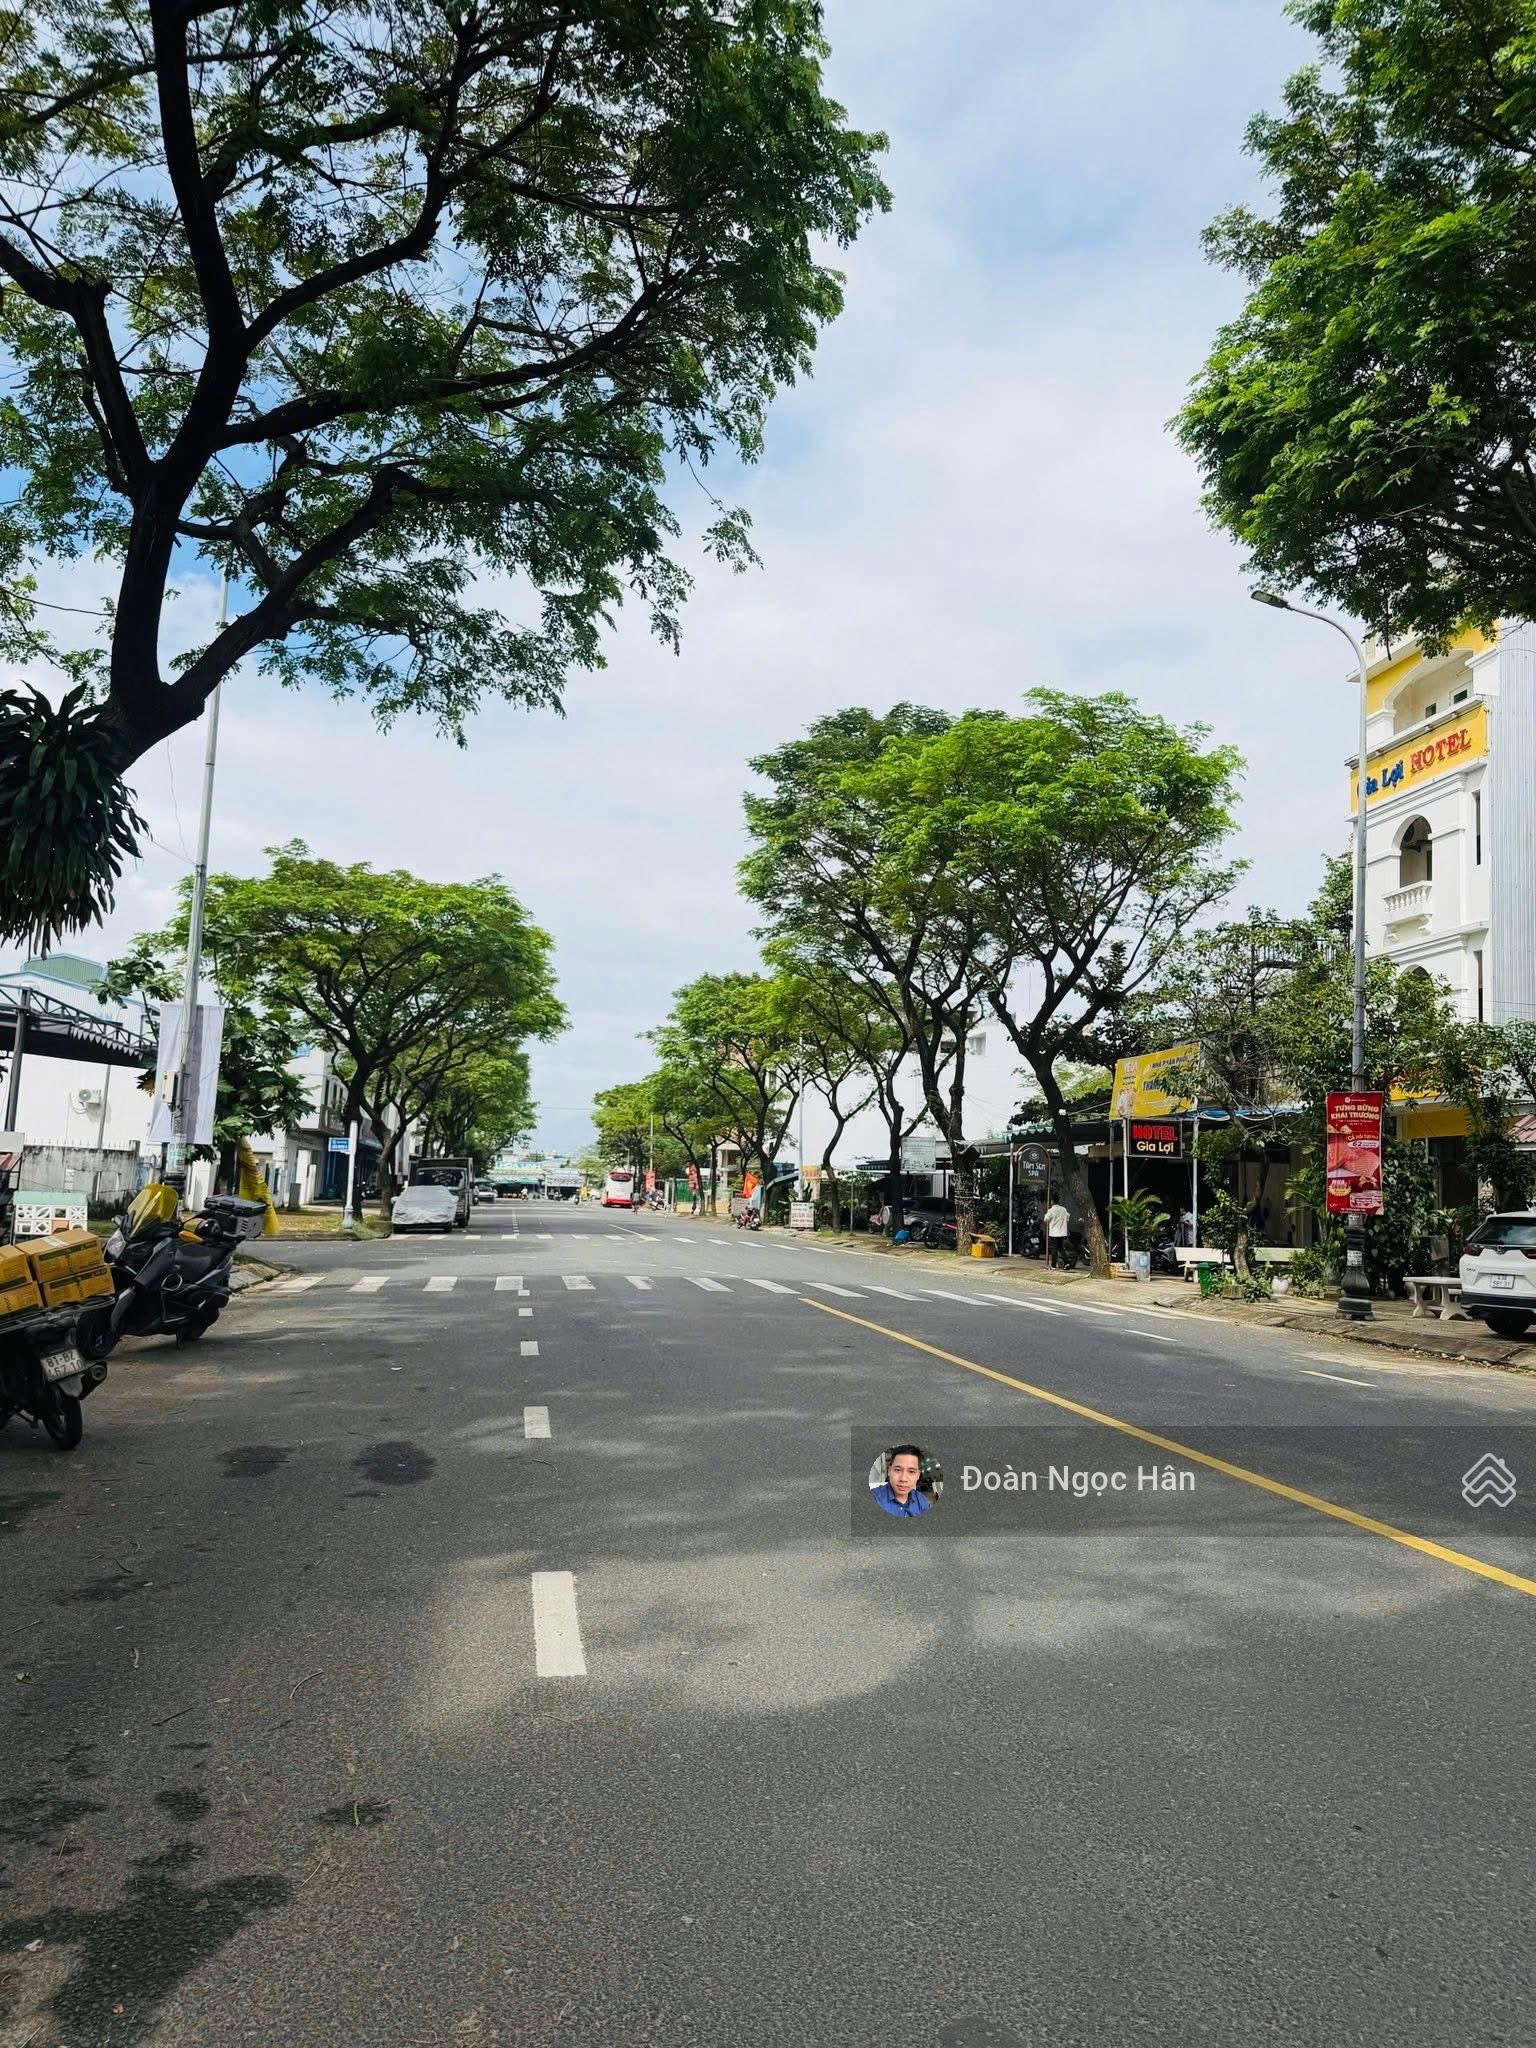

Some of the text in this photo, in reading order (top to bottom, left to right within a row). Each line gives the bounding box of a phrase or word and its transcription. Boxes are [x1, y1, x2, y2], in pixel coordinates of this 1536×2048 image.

[1382, 760, 1404, 792] Lợi
[1410, 728, 1472, 774] HOTEL
[1330, 1112, 1348, 1120] KHAI
[1136, 1141, 1174, 1154] Gia Lợi
